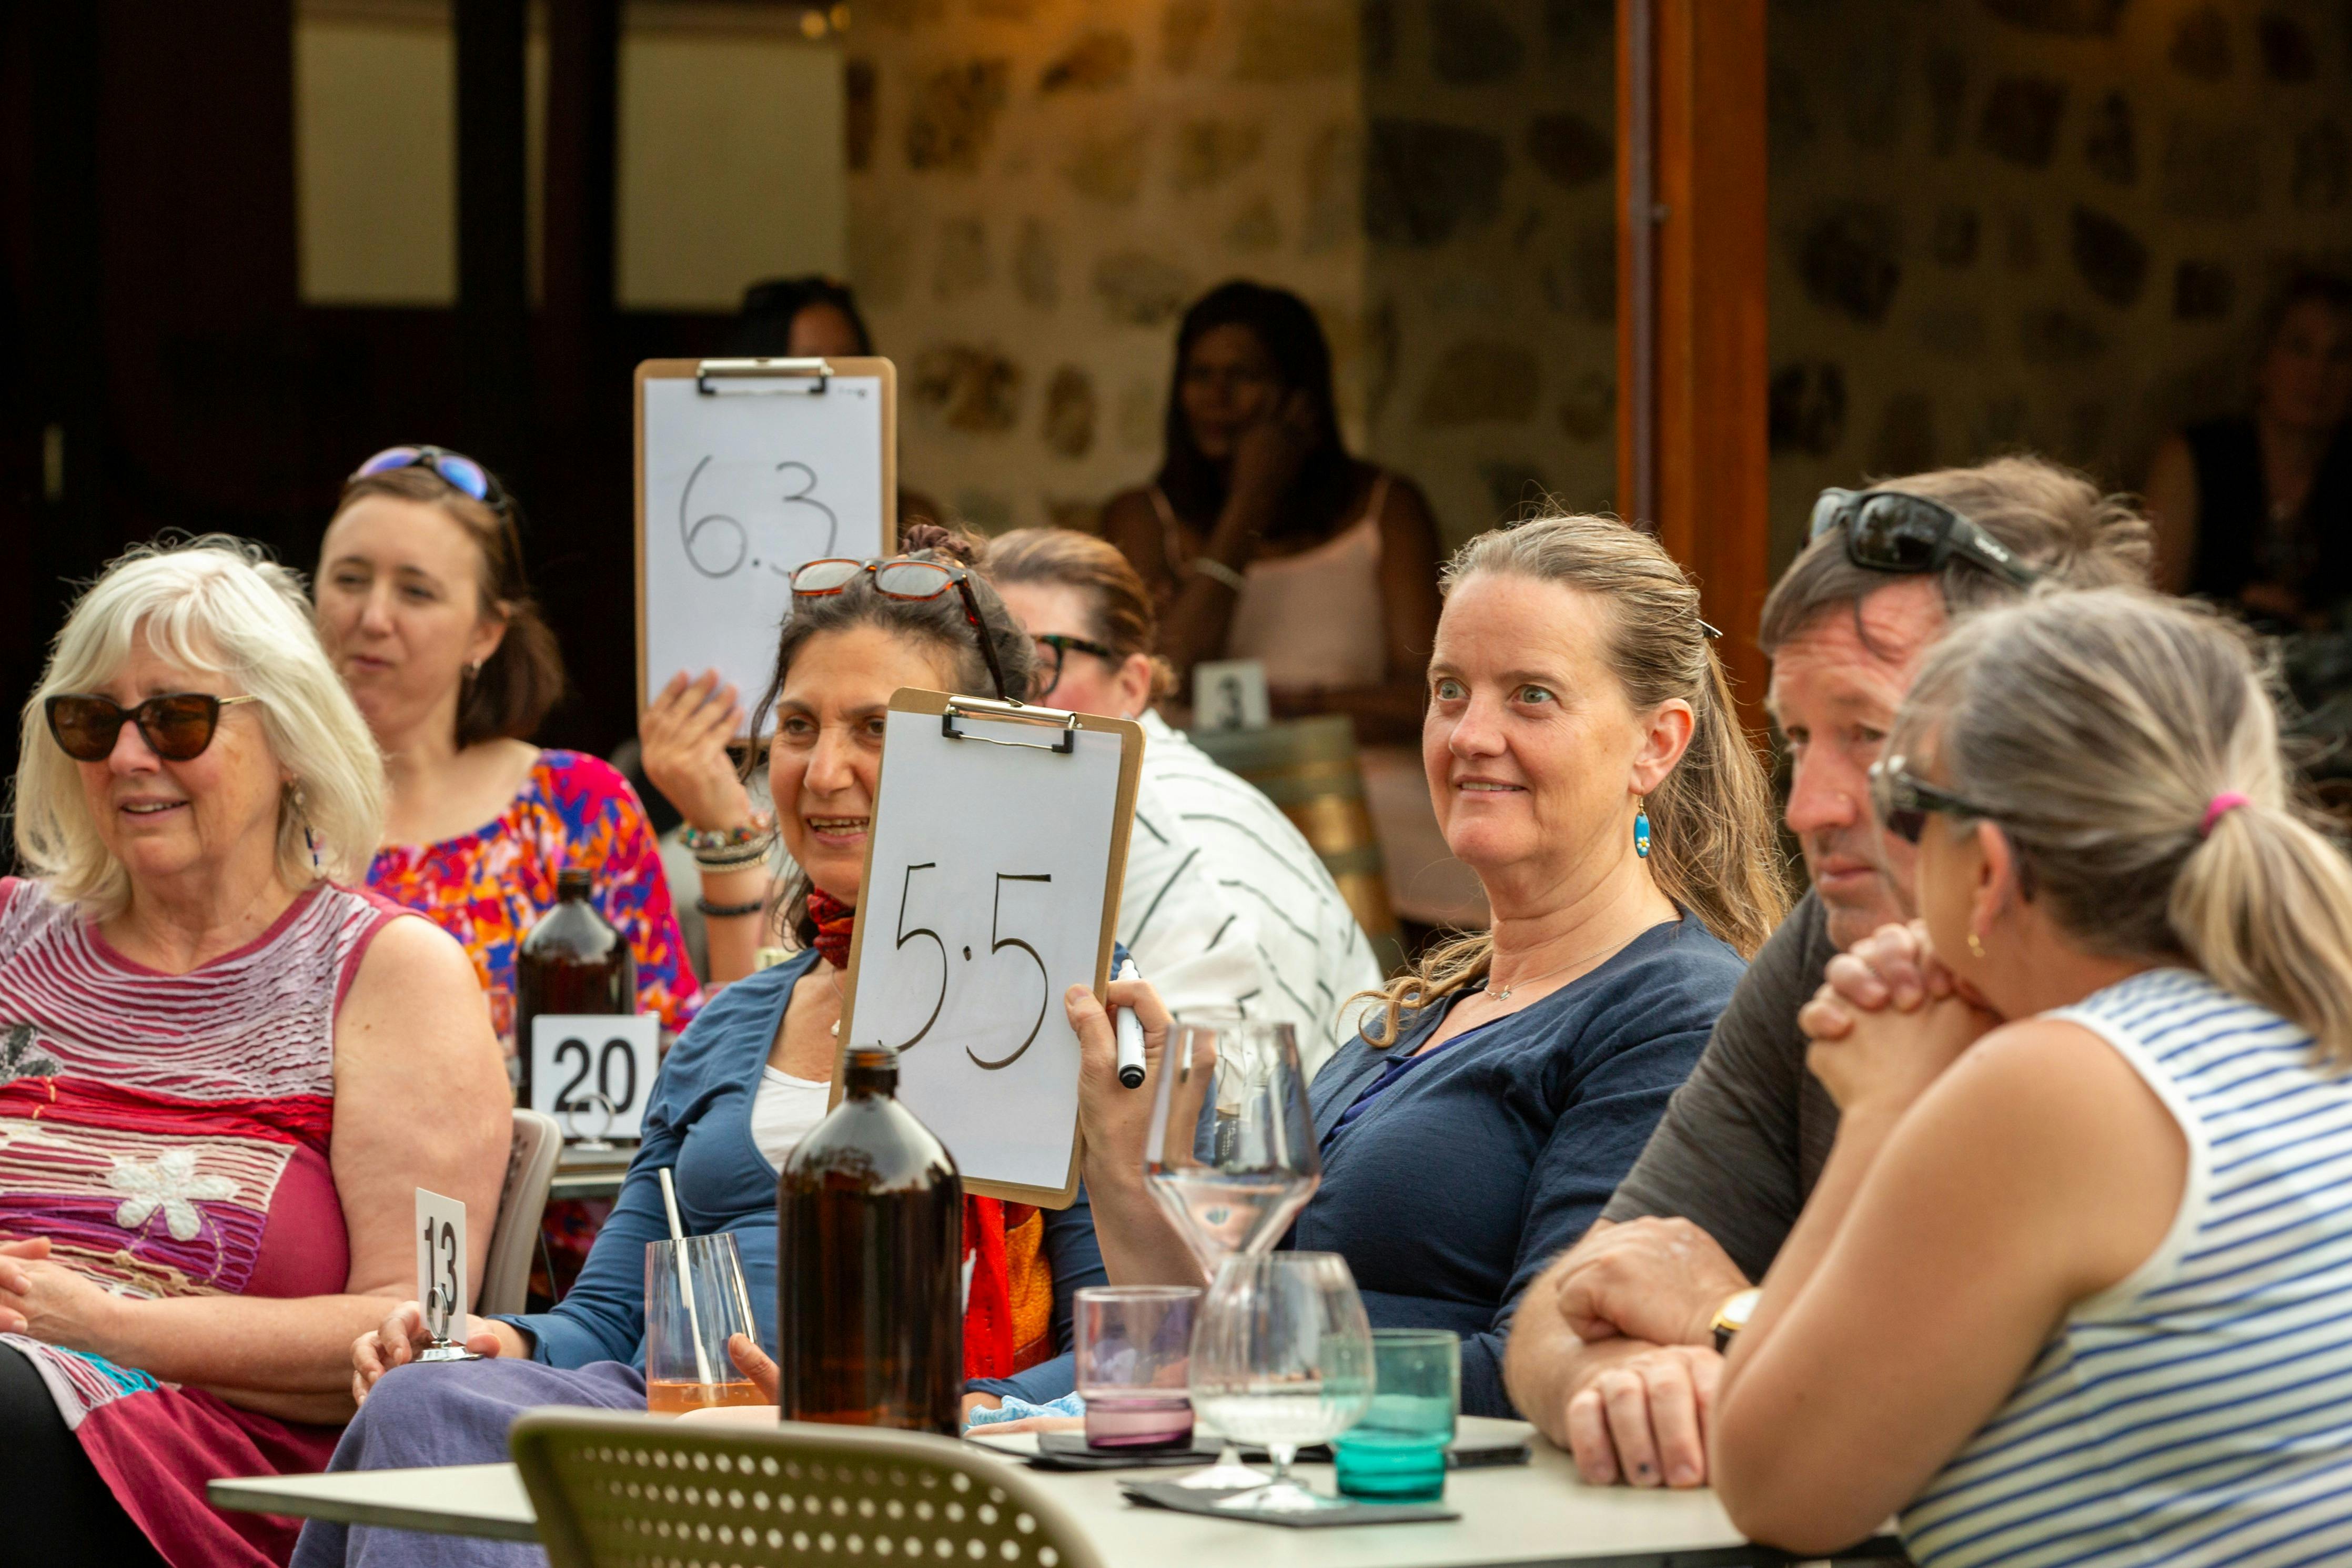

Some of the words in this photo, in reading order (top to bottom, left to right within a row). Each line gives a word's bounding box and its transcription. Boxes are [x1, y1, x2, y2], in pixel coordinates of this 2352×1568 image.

[679, 454, 838, 579] 6.3
[877, 862, 1052, 1071] 5.5
[553, 1037, 637, 1115] 20
[424, 1216, 458, 1316] 13
